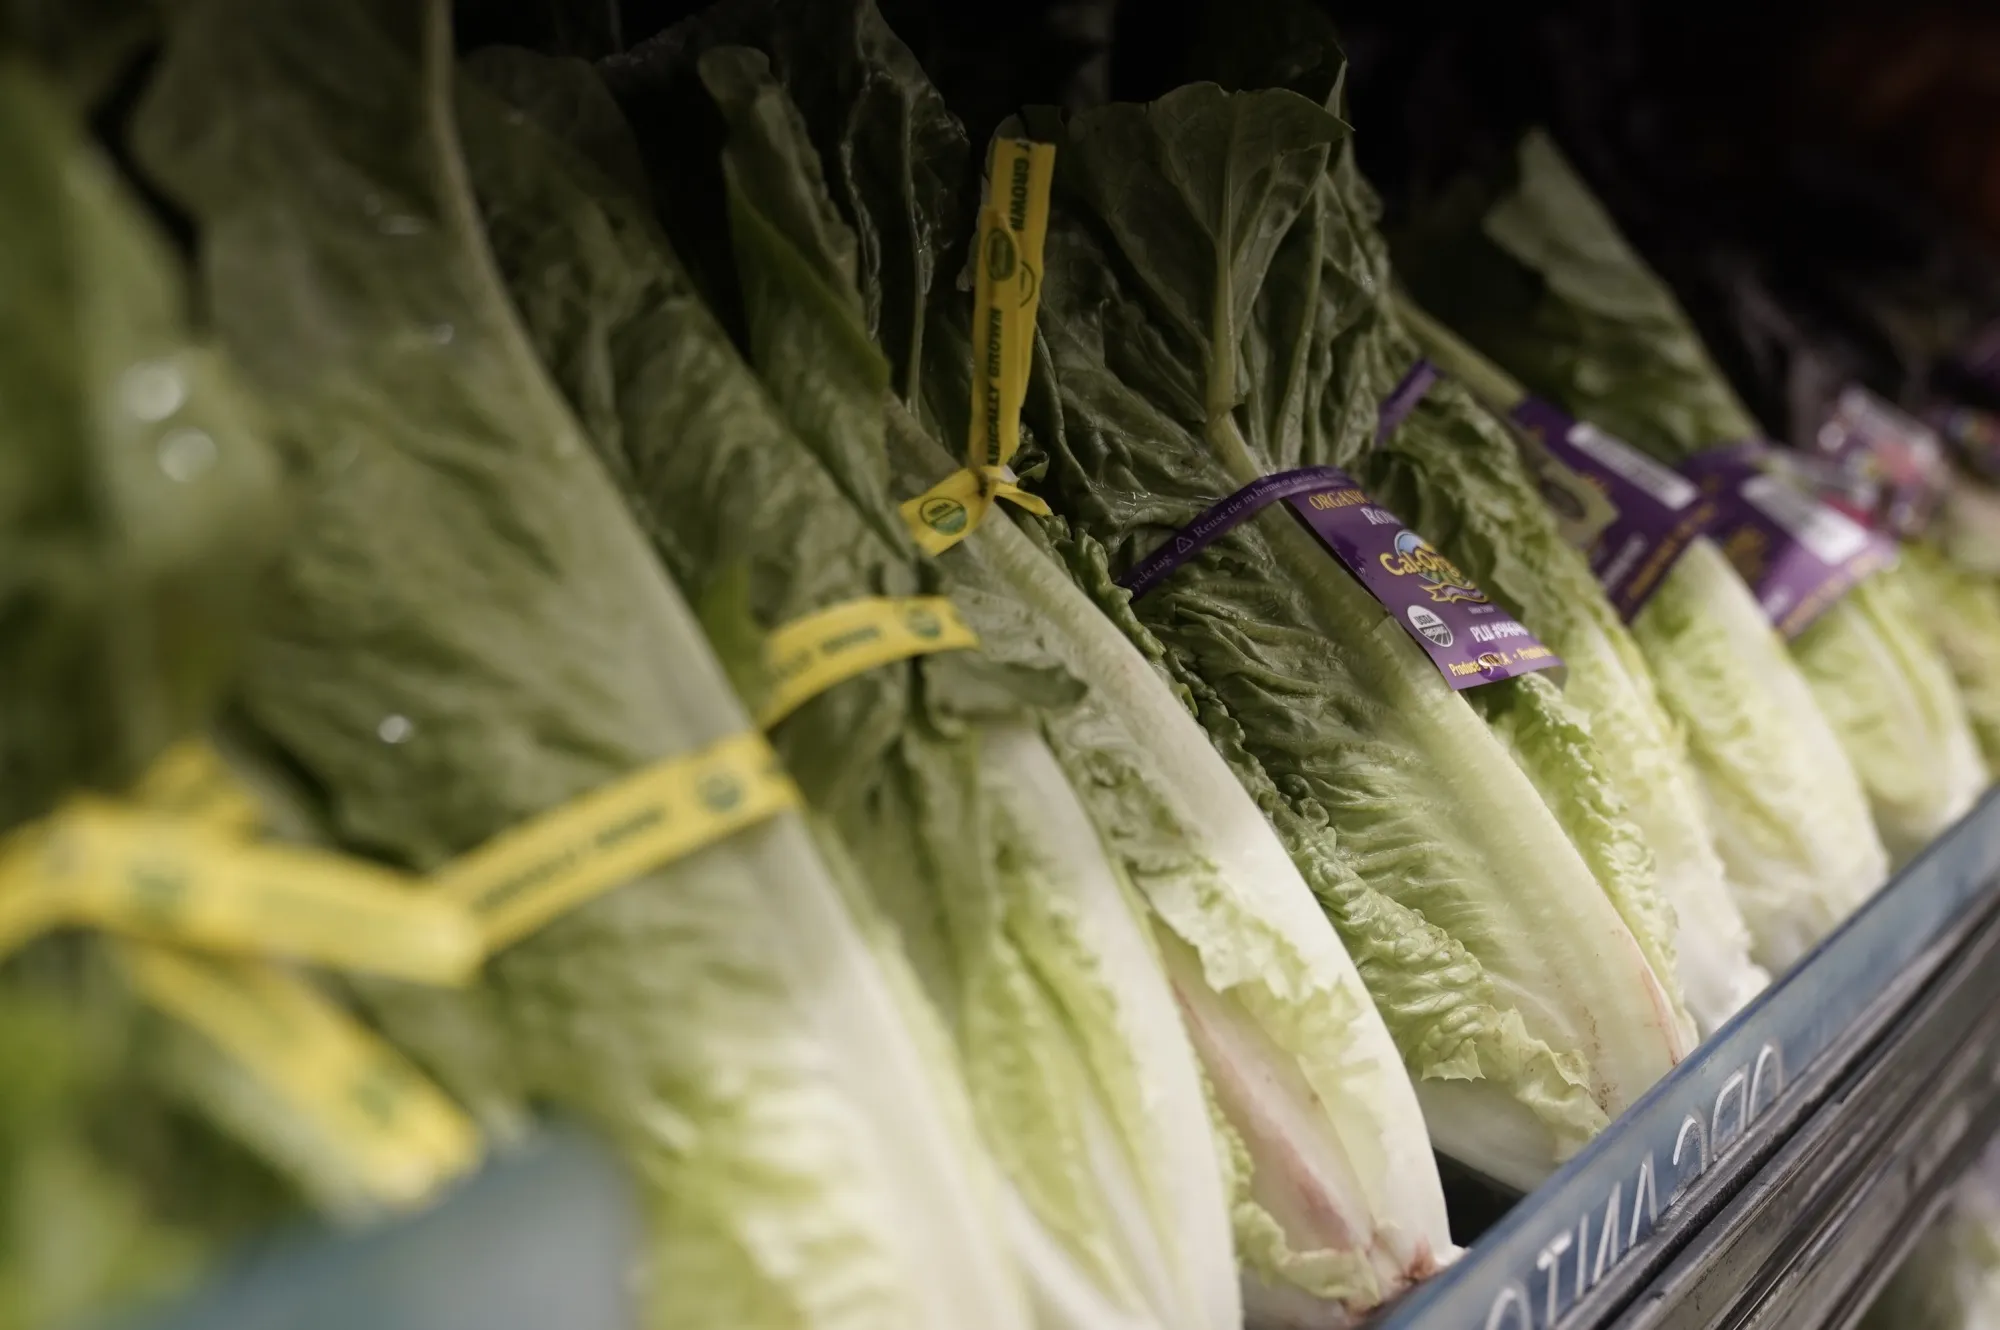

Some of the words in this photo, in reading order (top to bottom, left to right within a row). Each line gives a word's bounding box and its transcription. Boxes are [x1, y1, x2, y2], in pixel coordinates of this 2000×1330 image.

[1010, 158, 1030, 230] GROWN
[1308, 488, 1371, 510] ORGANIC
[1154, 552, 1173, 575] tag
[1193, 509, 1228, 539] Reuse
[1227, 501, 1243, 515] tie
[1243, 493, 1255, 506] in
[1254, 481, 1281, 498] home
[1413, 614, 1436, 625] USDA
[1469, 624, 1495, 642] PLU
